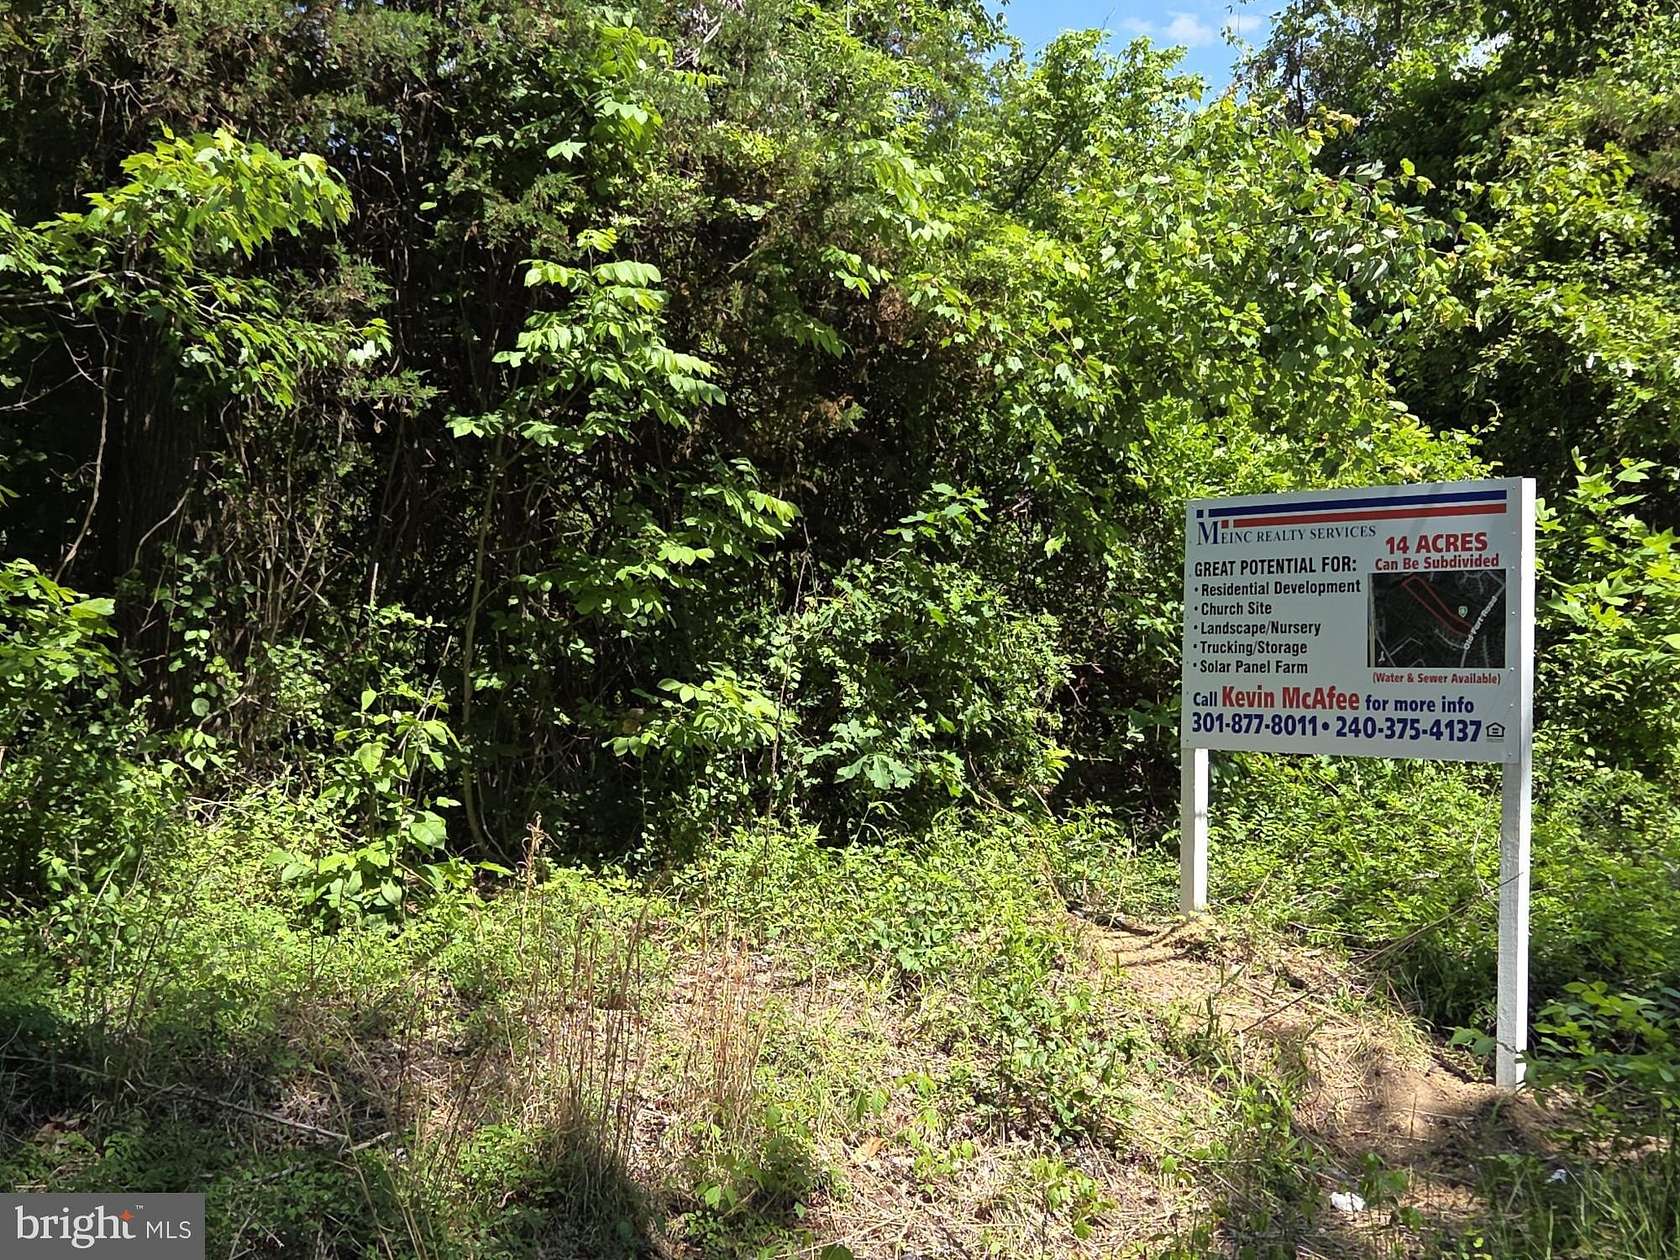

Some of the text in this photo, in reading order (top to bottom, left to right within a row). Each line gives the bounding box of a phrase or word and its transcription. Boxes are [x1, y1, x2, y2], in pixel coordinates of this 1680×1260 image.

[1197, 521, 1376, 545] MEINC REALTY SERVICES
[1385, 532, 1488, 554] 14 ACRES
[1195, 556, 1357, 577] GREAT POTENTIAL FOR:
[1375, 553, 1499, 571] Can Be Subdivided
[1201, 580, 1361, 596] Residential Development
[1201, 601, 1272, 616] Church Site
[1200, 620, 1321, 637] Landscape/Nursery
[1200, 640, 1308, 656] Trucking/Storage
[1200, 660, 1308, 674] Solar Panel Farm
[1372, 672, 1501, 685] (Water & Sewer Available)
[1193, 685, 1474, 713] Call Kevin McAfee for more info
[1192, 712, 1482, 742] 301-877-8011 240-375-4137
